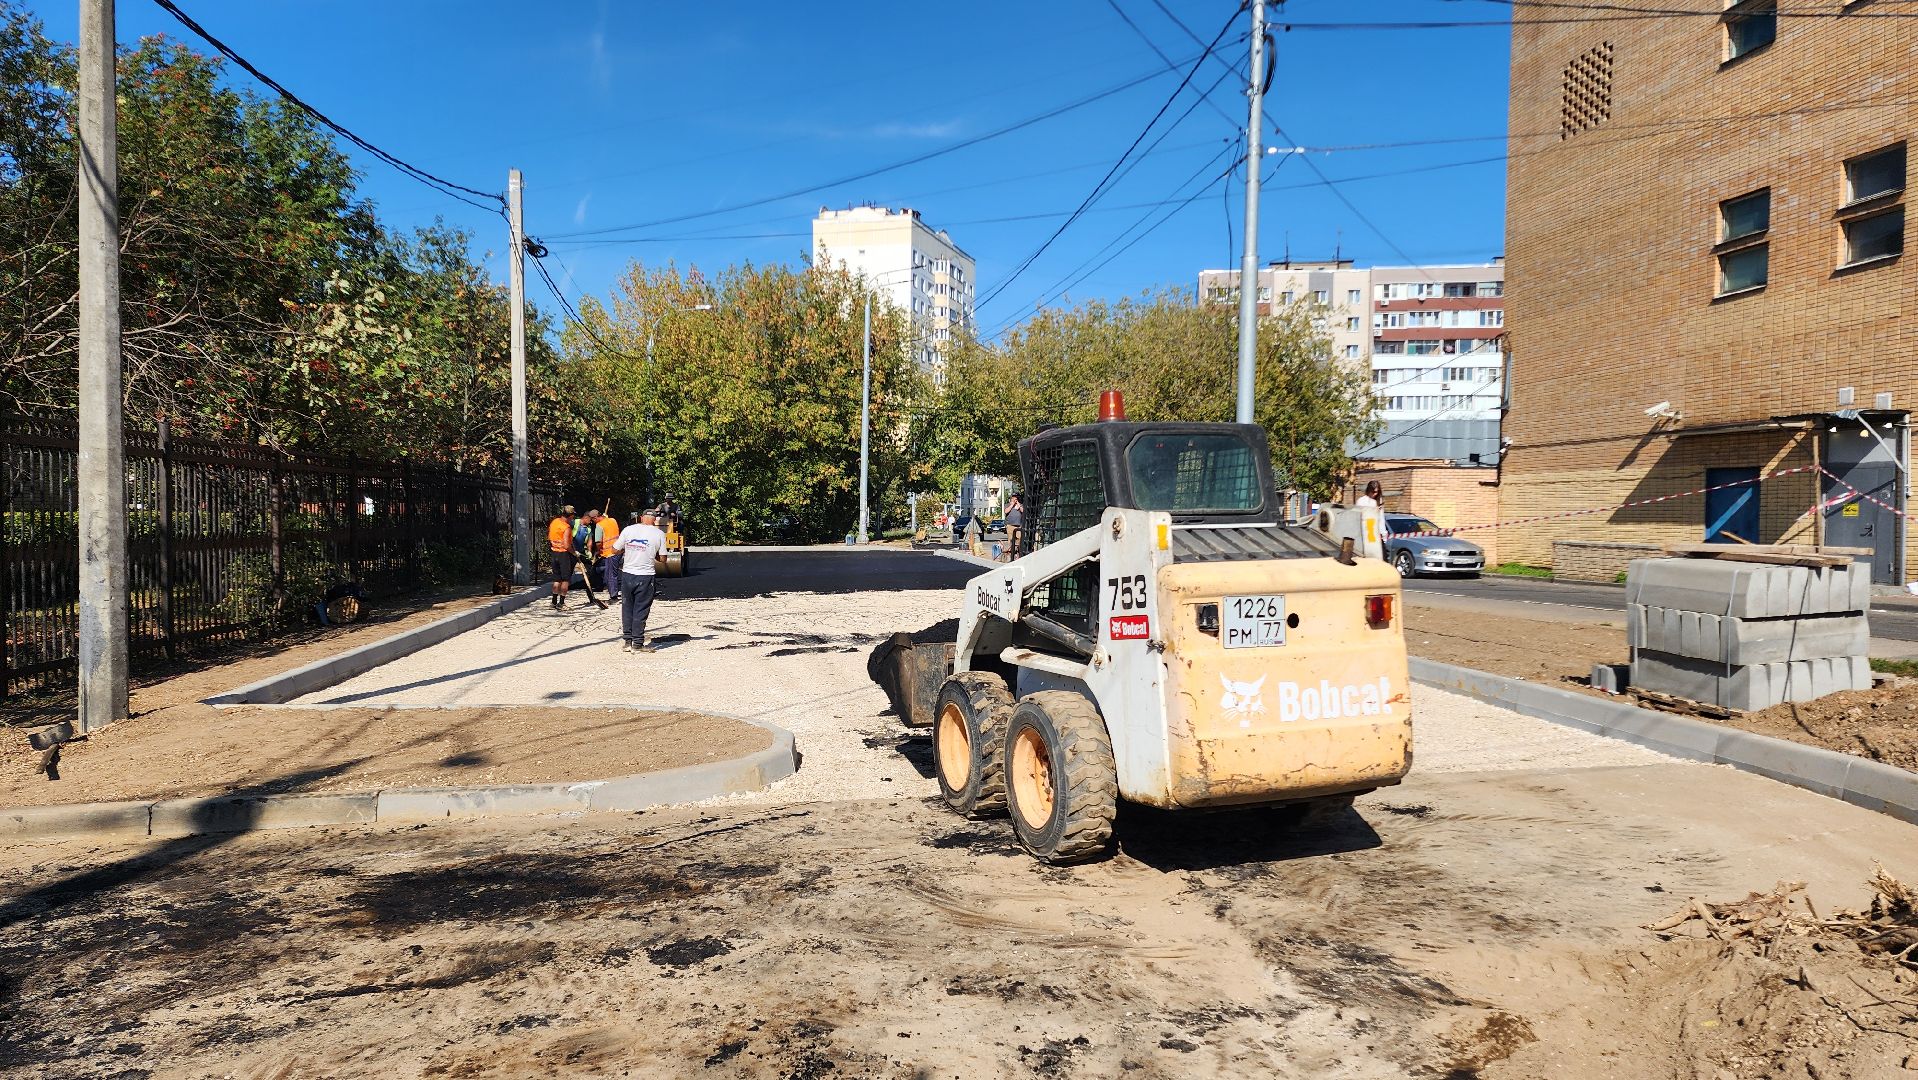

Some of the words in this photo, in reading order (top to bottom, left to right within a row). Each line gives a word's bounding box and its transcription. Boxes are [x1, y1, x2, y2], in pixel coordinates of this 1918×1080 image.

[977, 585, 1001, 613] Bobcat
[1108, 574, 1147, 611] 753
[1233, 597, 1277, 619] 1226
[1121, 621, 1148, 636] Bobcat
[1263, 621, 1281, 638] 77
[1278, 675, 1393, 722] Bobcat
